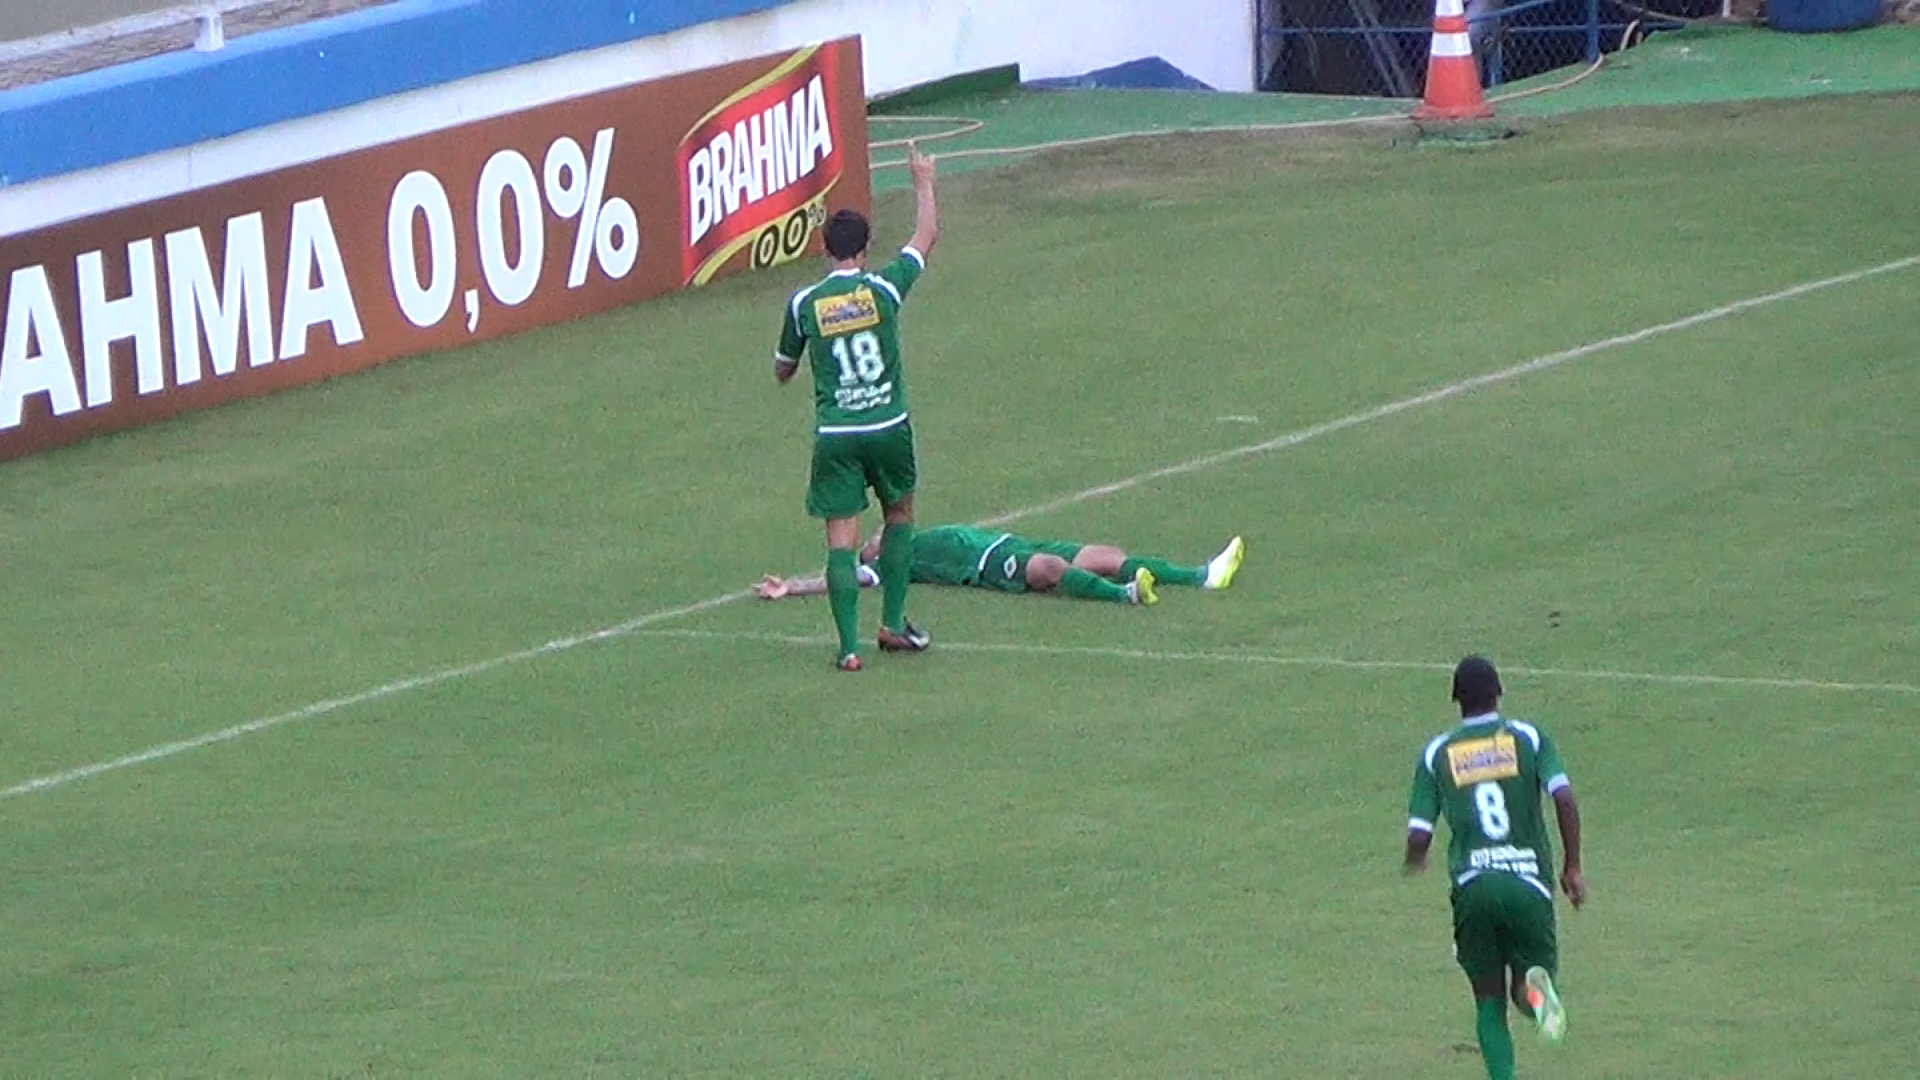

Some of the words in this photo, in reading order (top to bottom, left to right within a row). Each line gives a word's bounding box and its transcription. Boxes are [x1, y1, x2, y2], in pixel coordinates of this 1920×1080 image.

[688, 74, 833, 247] BRAHMA
[0, 196, 364, 431] AHMA
[387, 128, 640, 334] 0,0%
[832, 331, 885, 386] 18
[1475, 781, 1510, 840] 8
